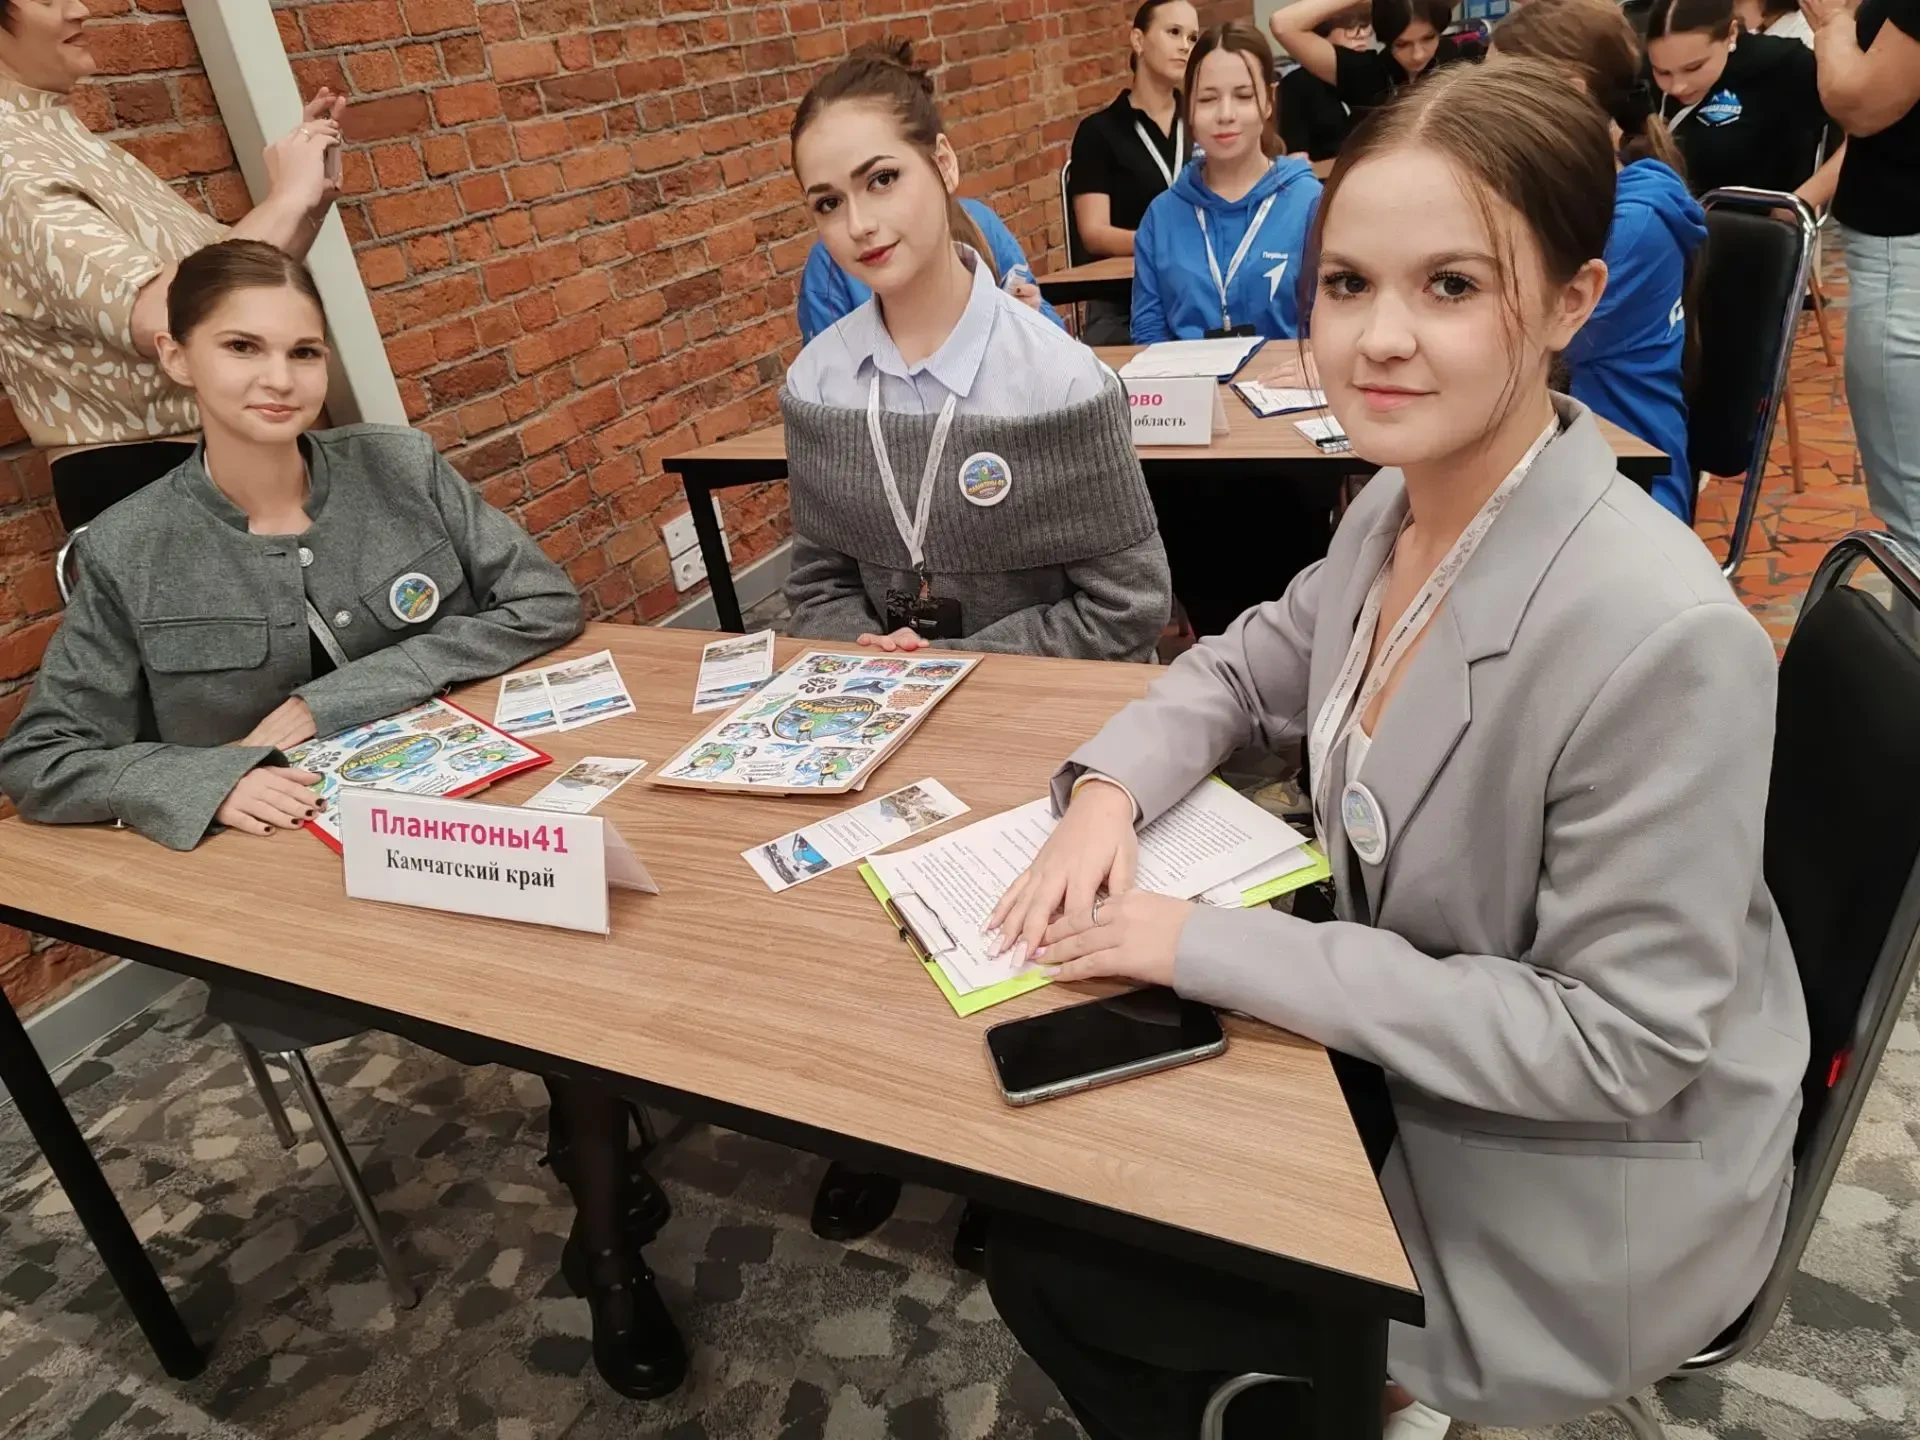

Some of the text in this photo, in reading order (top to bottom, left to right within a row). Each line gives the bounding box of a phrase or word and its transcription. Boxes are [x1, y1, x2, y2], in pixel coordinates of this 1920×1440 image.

[1134, 414, 1186, 427] область
[371, 808, 568, 853] Планктоны41
[386, 848, 555, 890] Камчатский край
